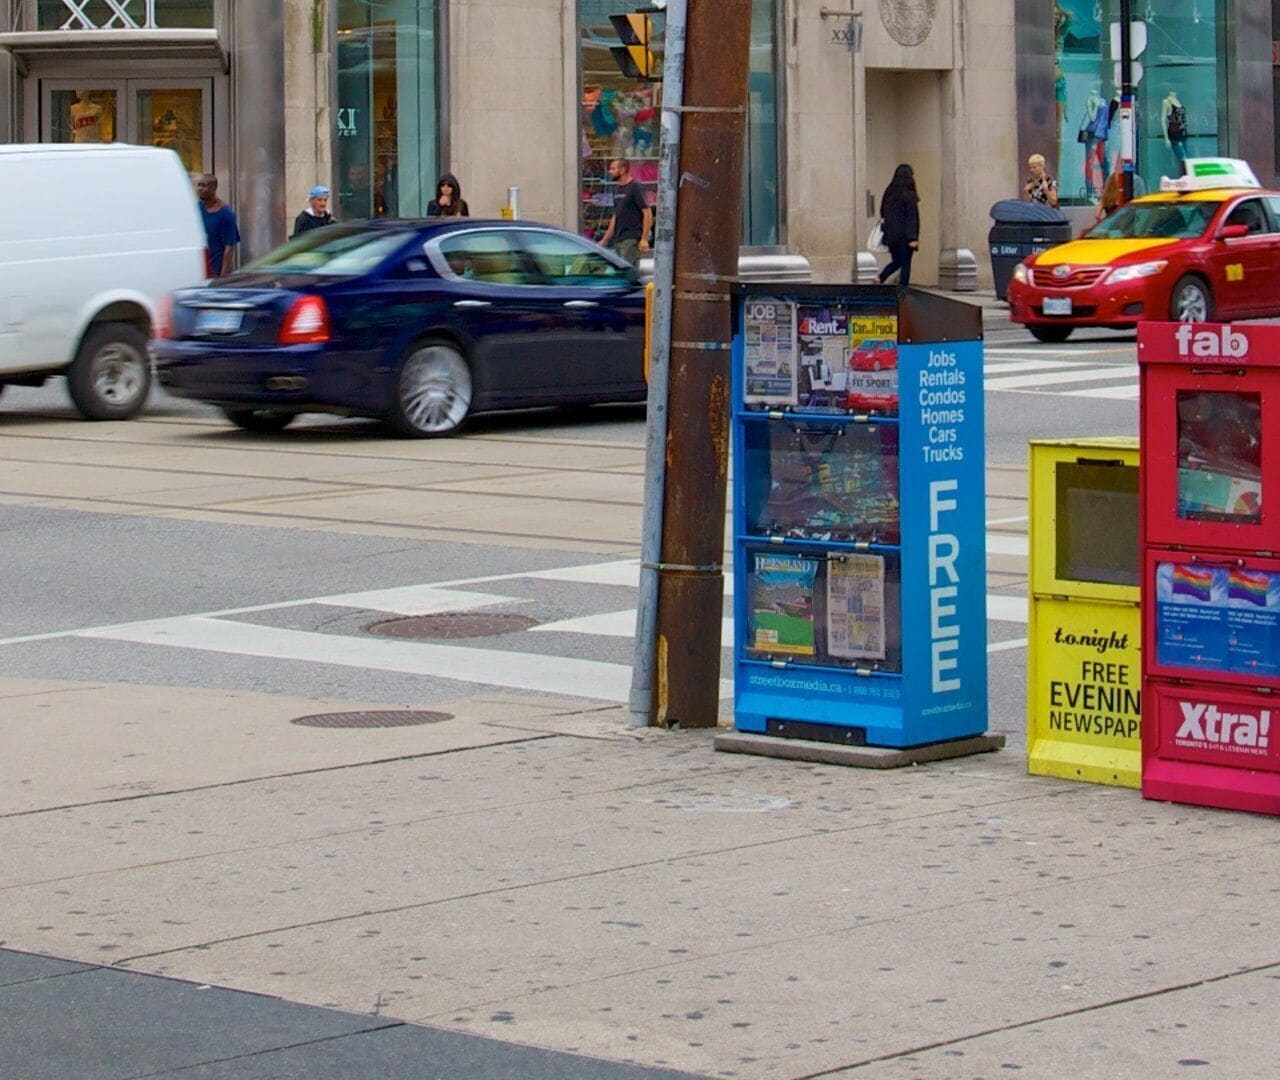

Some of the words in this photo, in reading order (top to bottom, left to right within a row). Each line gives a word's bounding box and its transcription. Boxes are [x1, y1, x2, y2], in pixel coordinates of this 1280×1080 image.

[1000, 245, 1018, 255] Litter
[747, 304, 776, 319] JOB
[1175, 324, 1249, 358] fab
[928, 350, 957, 368] Jobs
[920, 368, 966, 387] Rentals
[919, 387, 966, 406] Condos
[921, 407, 964, 425] Homes
[929, 426, 957, 444] Cars
[922, 444, 964, 463] Trucks
[928, 478, 961, 695] FREE
[1054, 627, 1128, 654] t.o.night
[1082, 660, 1129, 686] FREE
[1050, 680, 1141, 716] EVENIN
[1049, 710, 1141, 739] NEWSPAP
[1175, 701, 1271, 748] Xtra!
